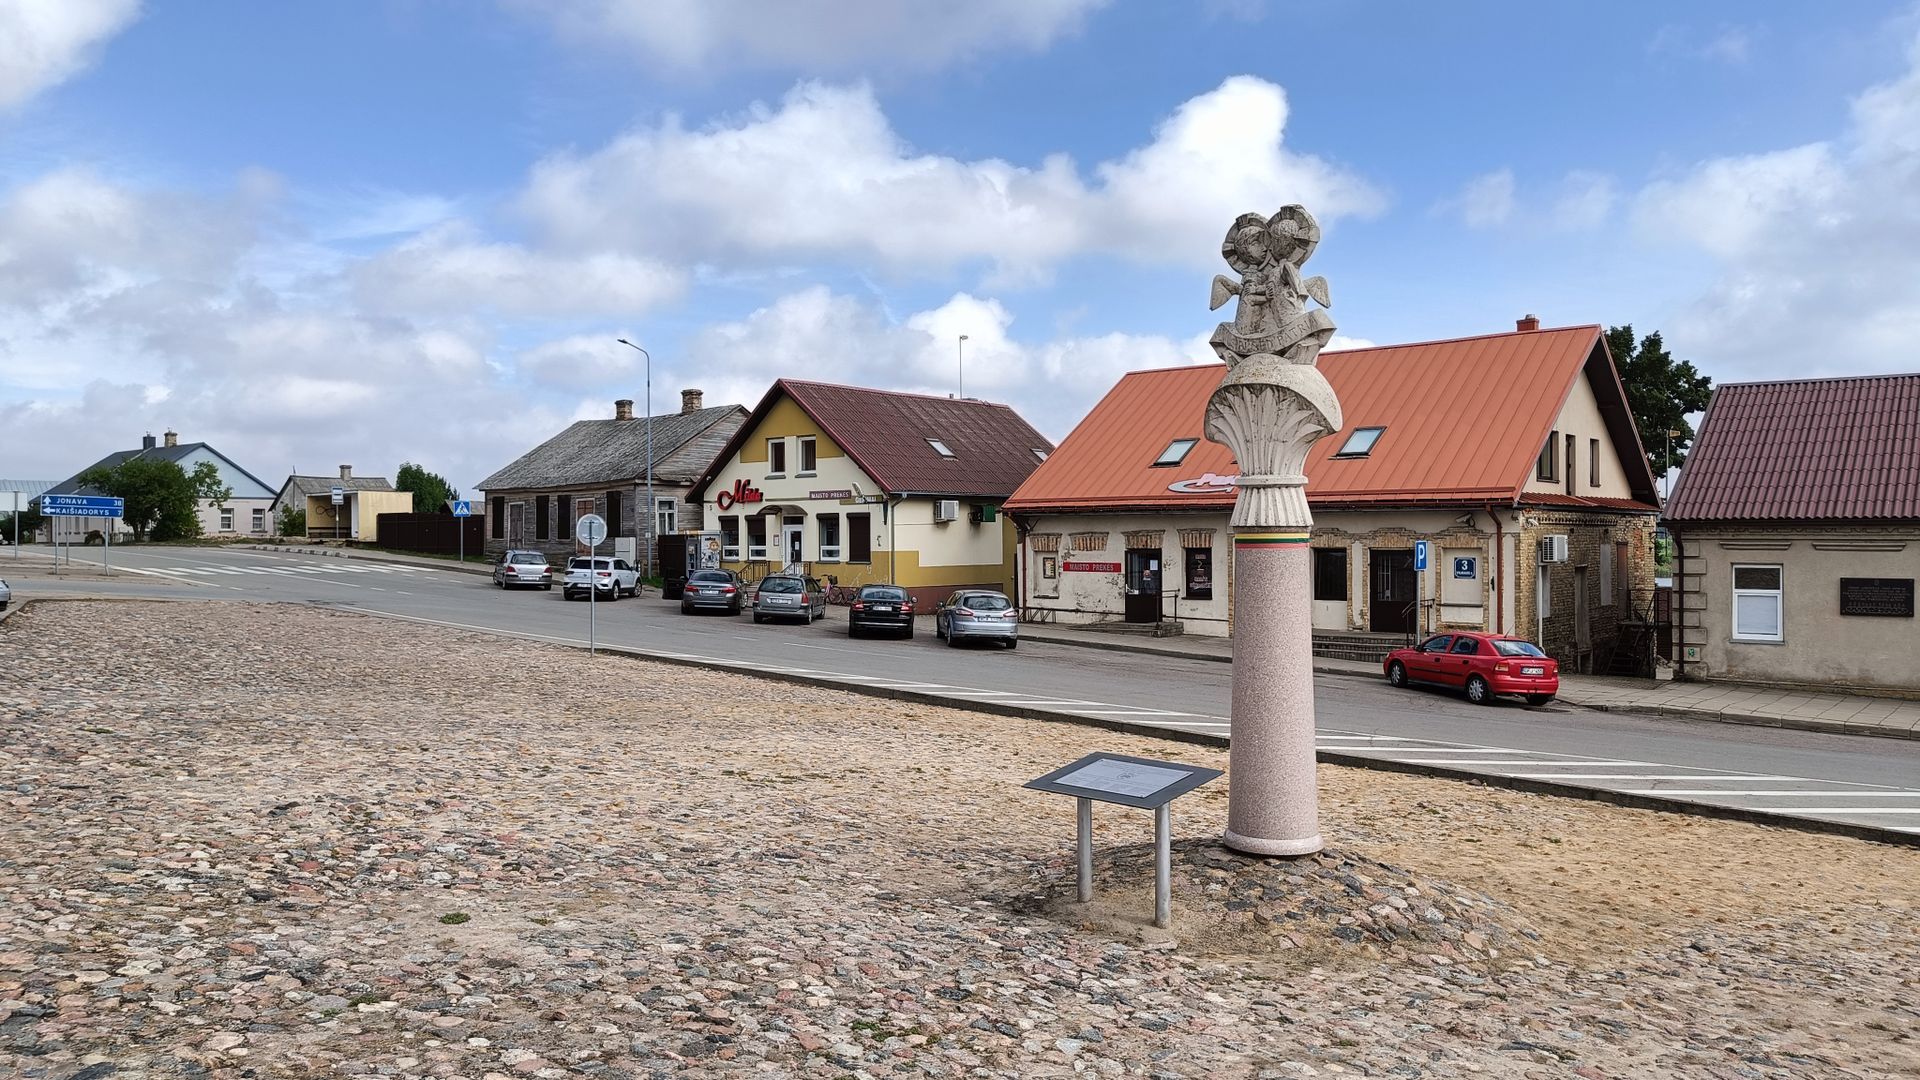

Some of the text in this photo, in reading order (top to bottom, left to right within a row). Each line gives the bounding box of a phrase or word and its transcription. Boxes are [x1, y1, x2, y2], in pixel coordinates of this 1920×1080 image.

[56, 507, 110, 516] KAIŠIADORYS
[1418, 544, 1425, 567] P
[1461, 560, 1468, 571] 3
